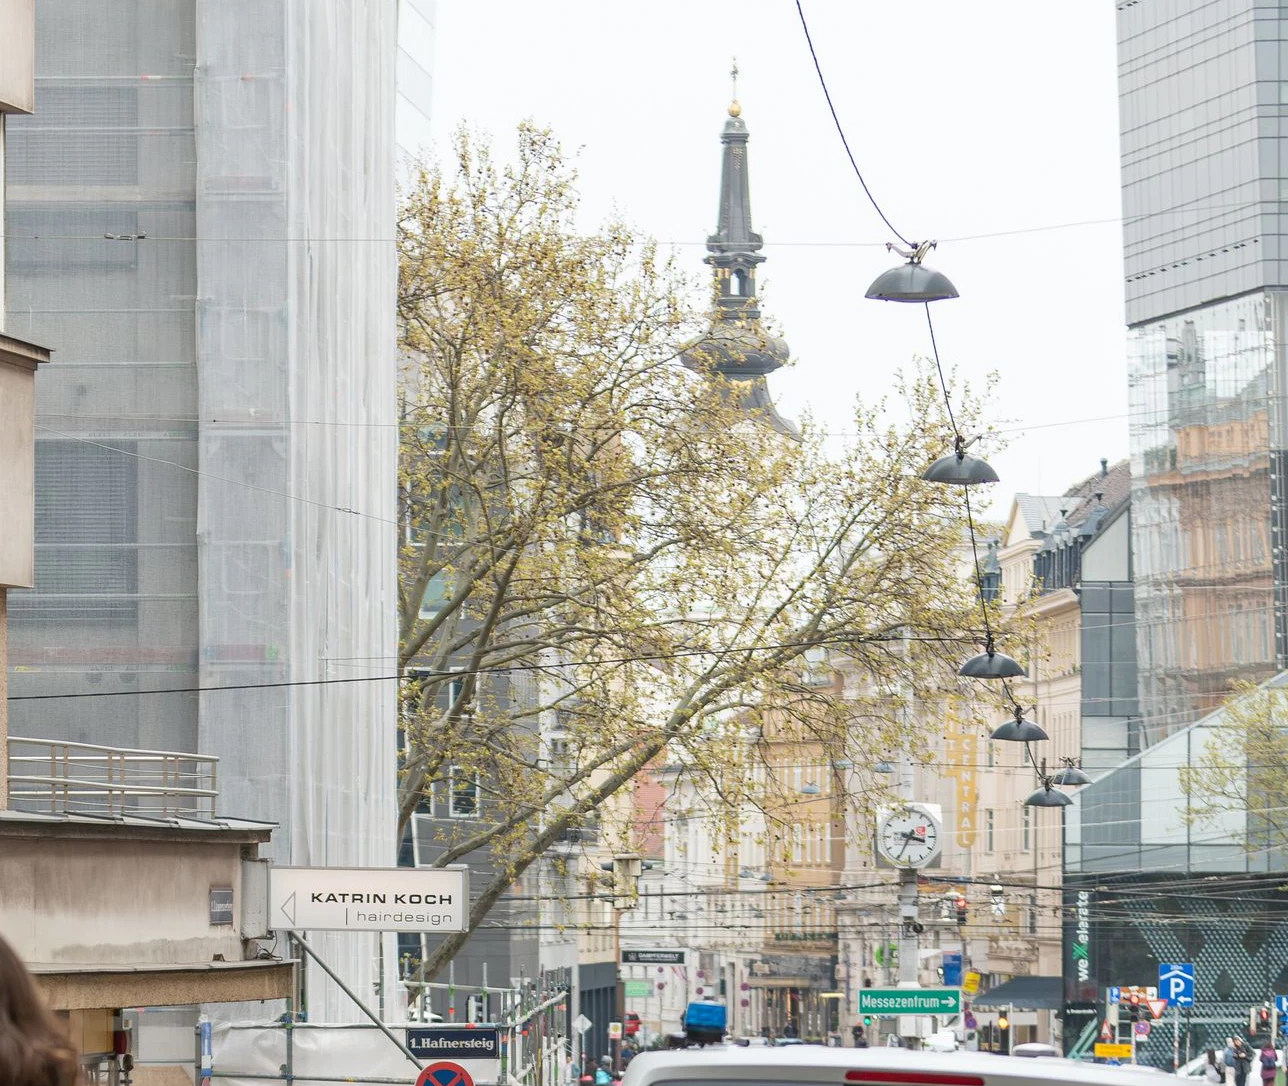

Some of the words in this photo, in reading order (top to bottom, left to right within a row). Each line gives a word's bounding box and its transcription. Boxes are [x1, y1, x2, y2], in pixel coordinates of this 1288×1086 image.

[311, 892, 387, 905] KATRIN
[394, 893, 453, 906] KOCH
[357, 911, 453, 926] hairdesign
[861, 994, 939, 1008] Messezentrum
